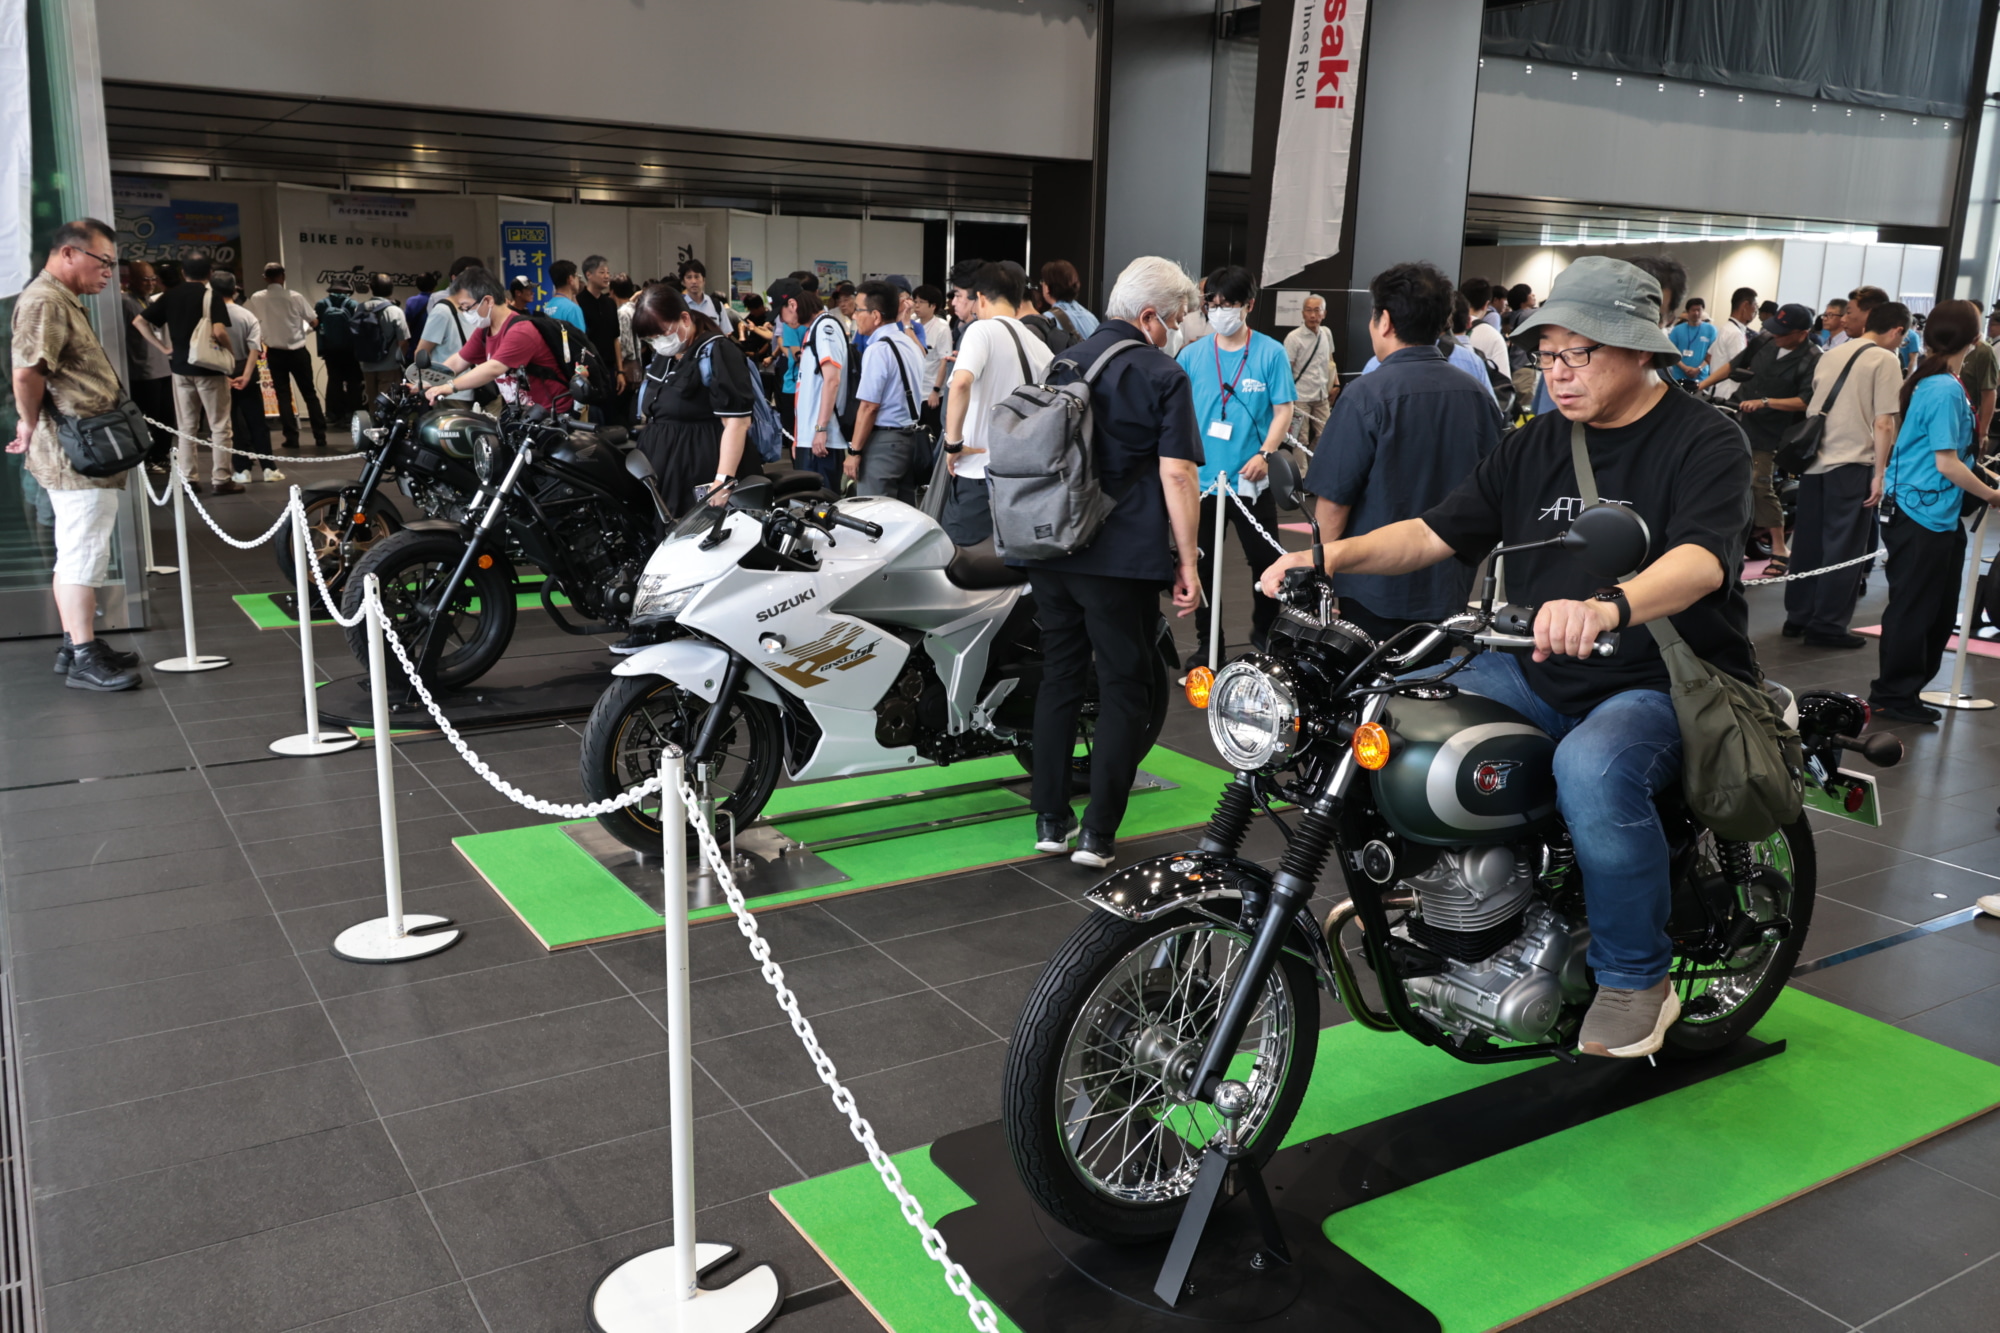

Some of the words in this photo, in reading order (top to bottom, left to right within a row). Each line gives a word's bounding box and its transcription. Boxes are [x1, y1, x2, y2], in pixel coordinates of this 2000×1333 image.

[1295, 61, 1309, 100] Roll
[299, 232, 338, 245] BIKE
[345, 236, 364, 246] no
[371, 237, 454, 250] FURUSATO
[438, 431, 460, 439] YAMAHA
[756, 588, 816, 622] SUZUKI
[1481, 773, 1495, 785] W
